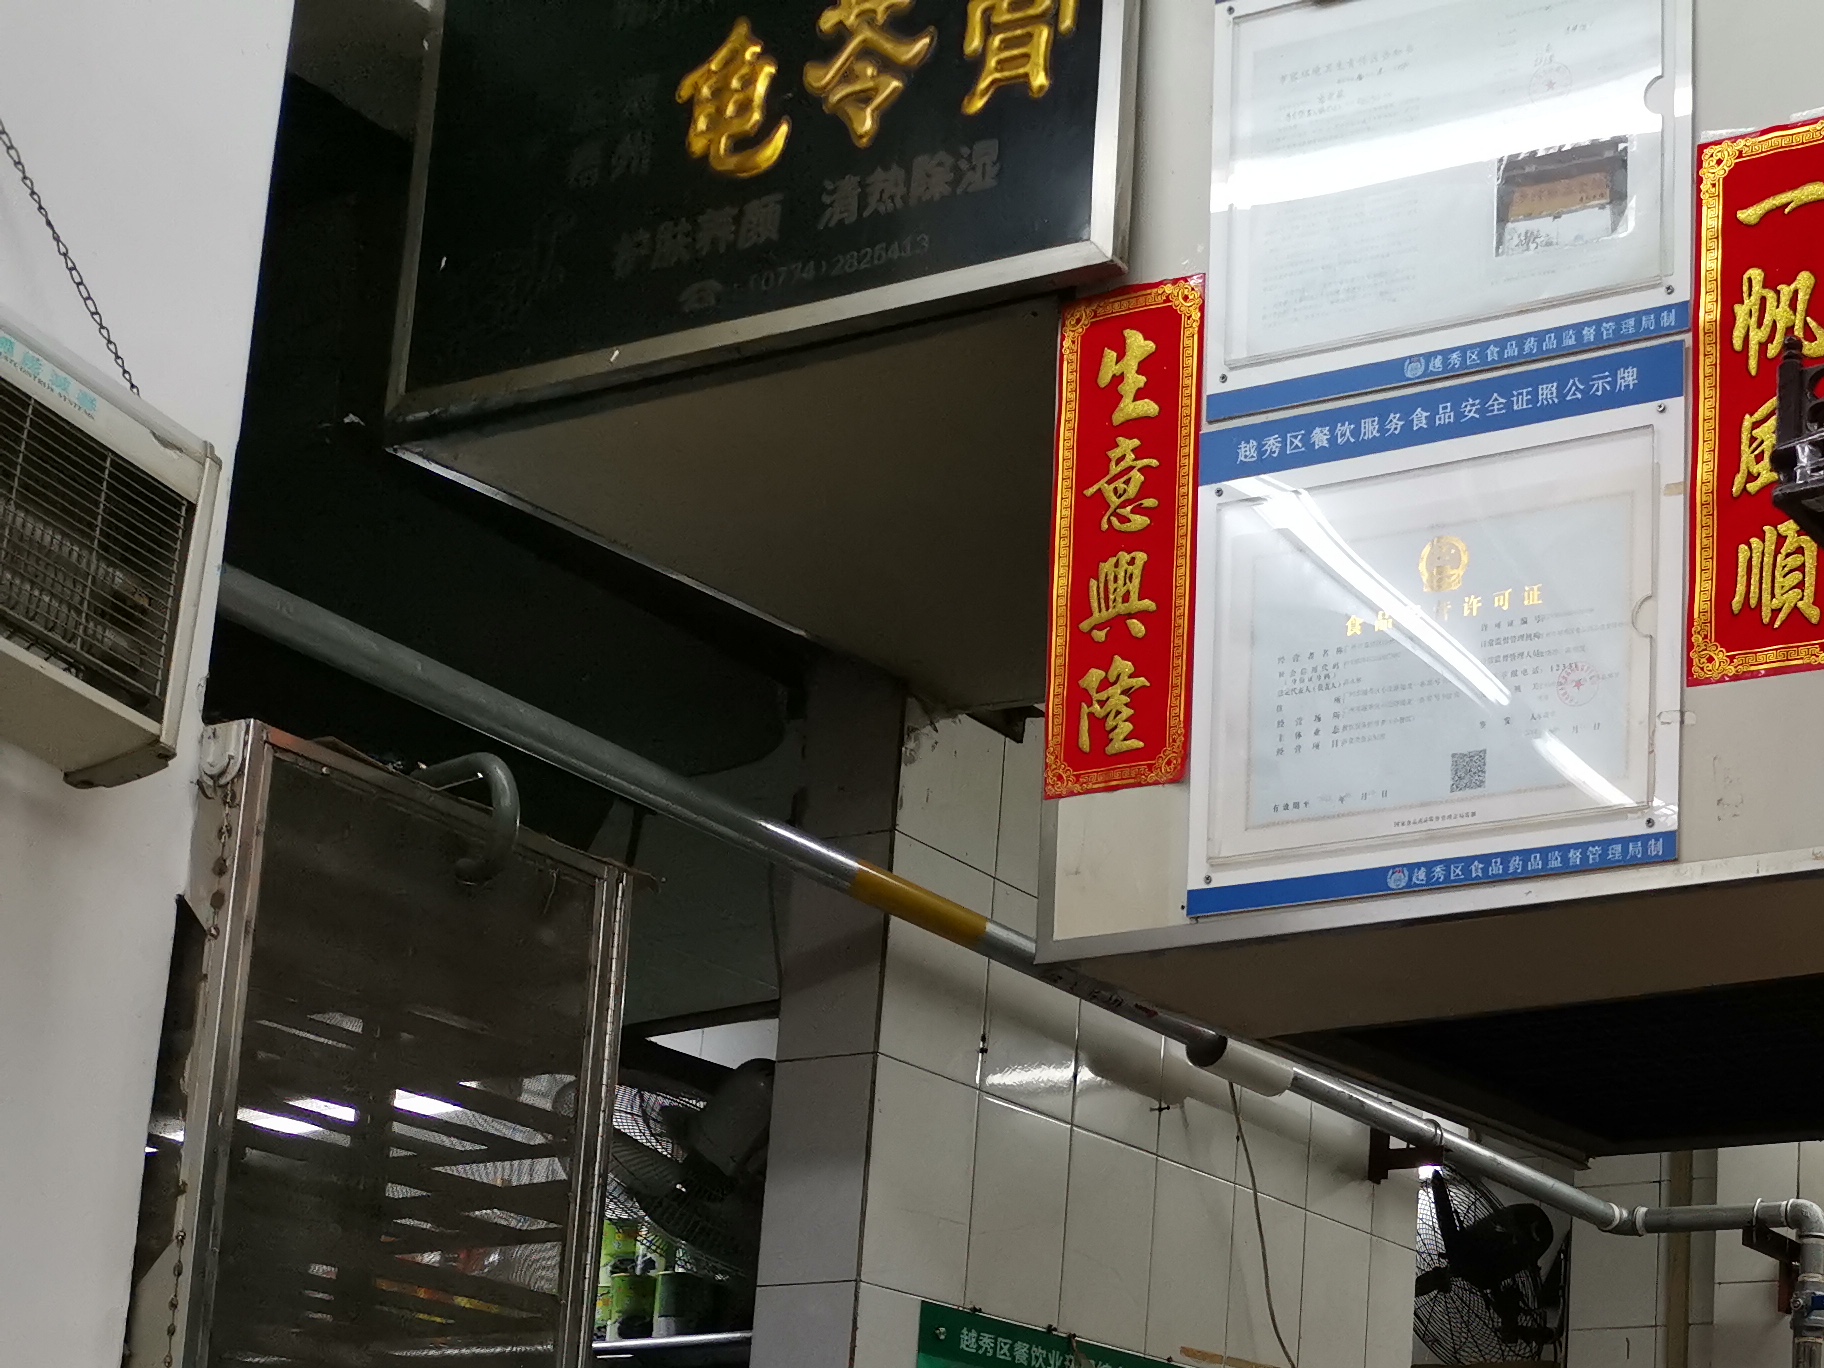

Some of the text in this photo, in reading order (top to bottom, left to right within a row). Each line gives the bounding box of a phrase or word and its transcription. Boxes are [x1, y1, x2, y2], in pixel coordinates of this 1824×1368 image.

[1426, 306, 1678, 375] 越秀区食品药品监督管理局制
[1236, 365, 1640, 464] 越秀区餐饮服务食品安全证照公示牌
[1410, 836, 1665, 889] 越秀区食品药品监督管理局制
